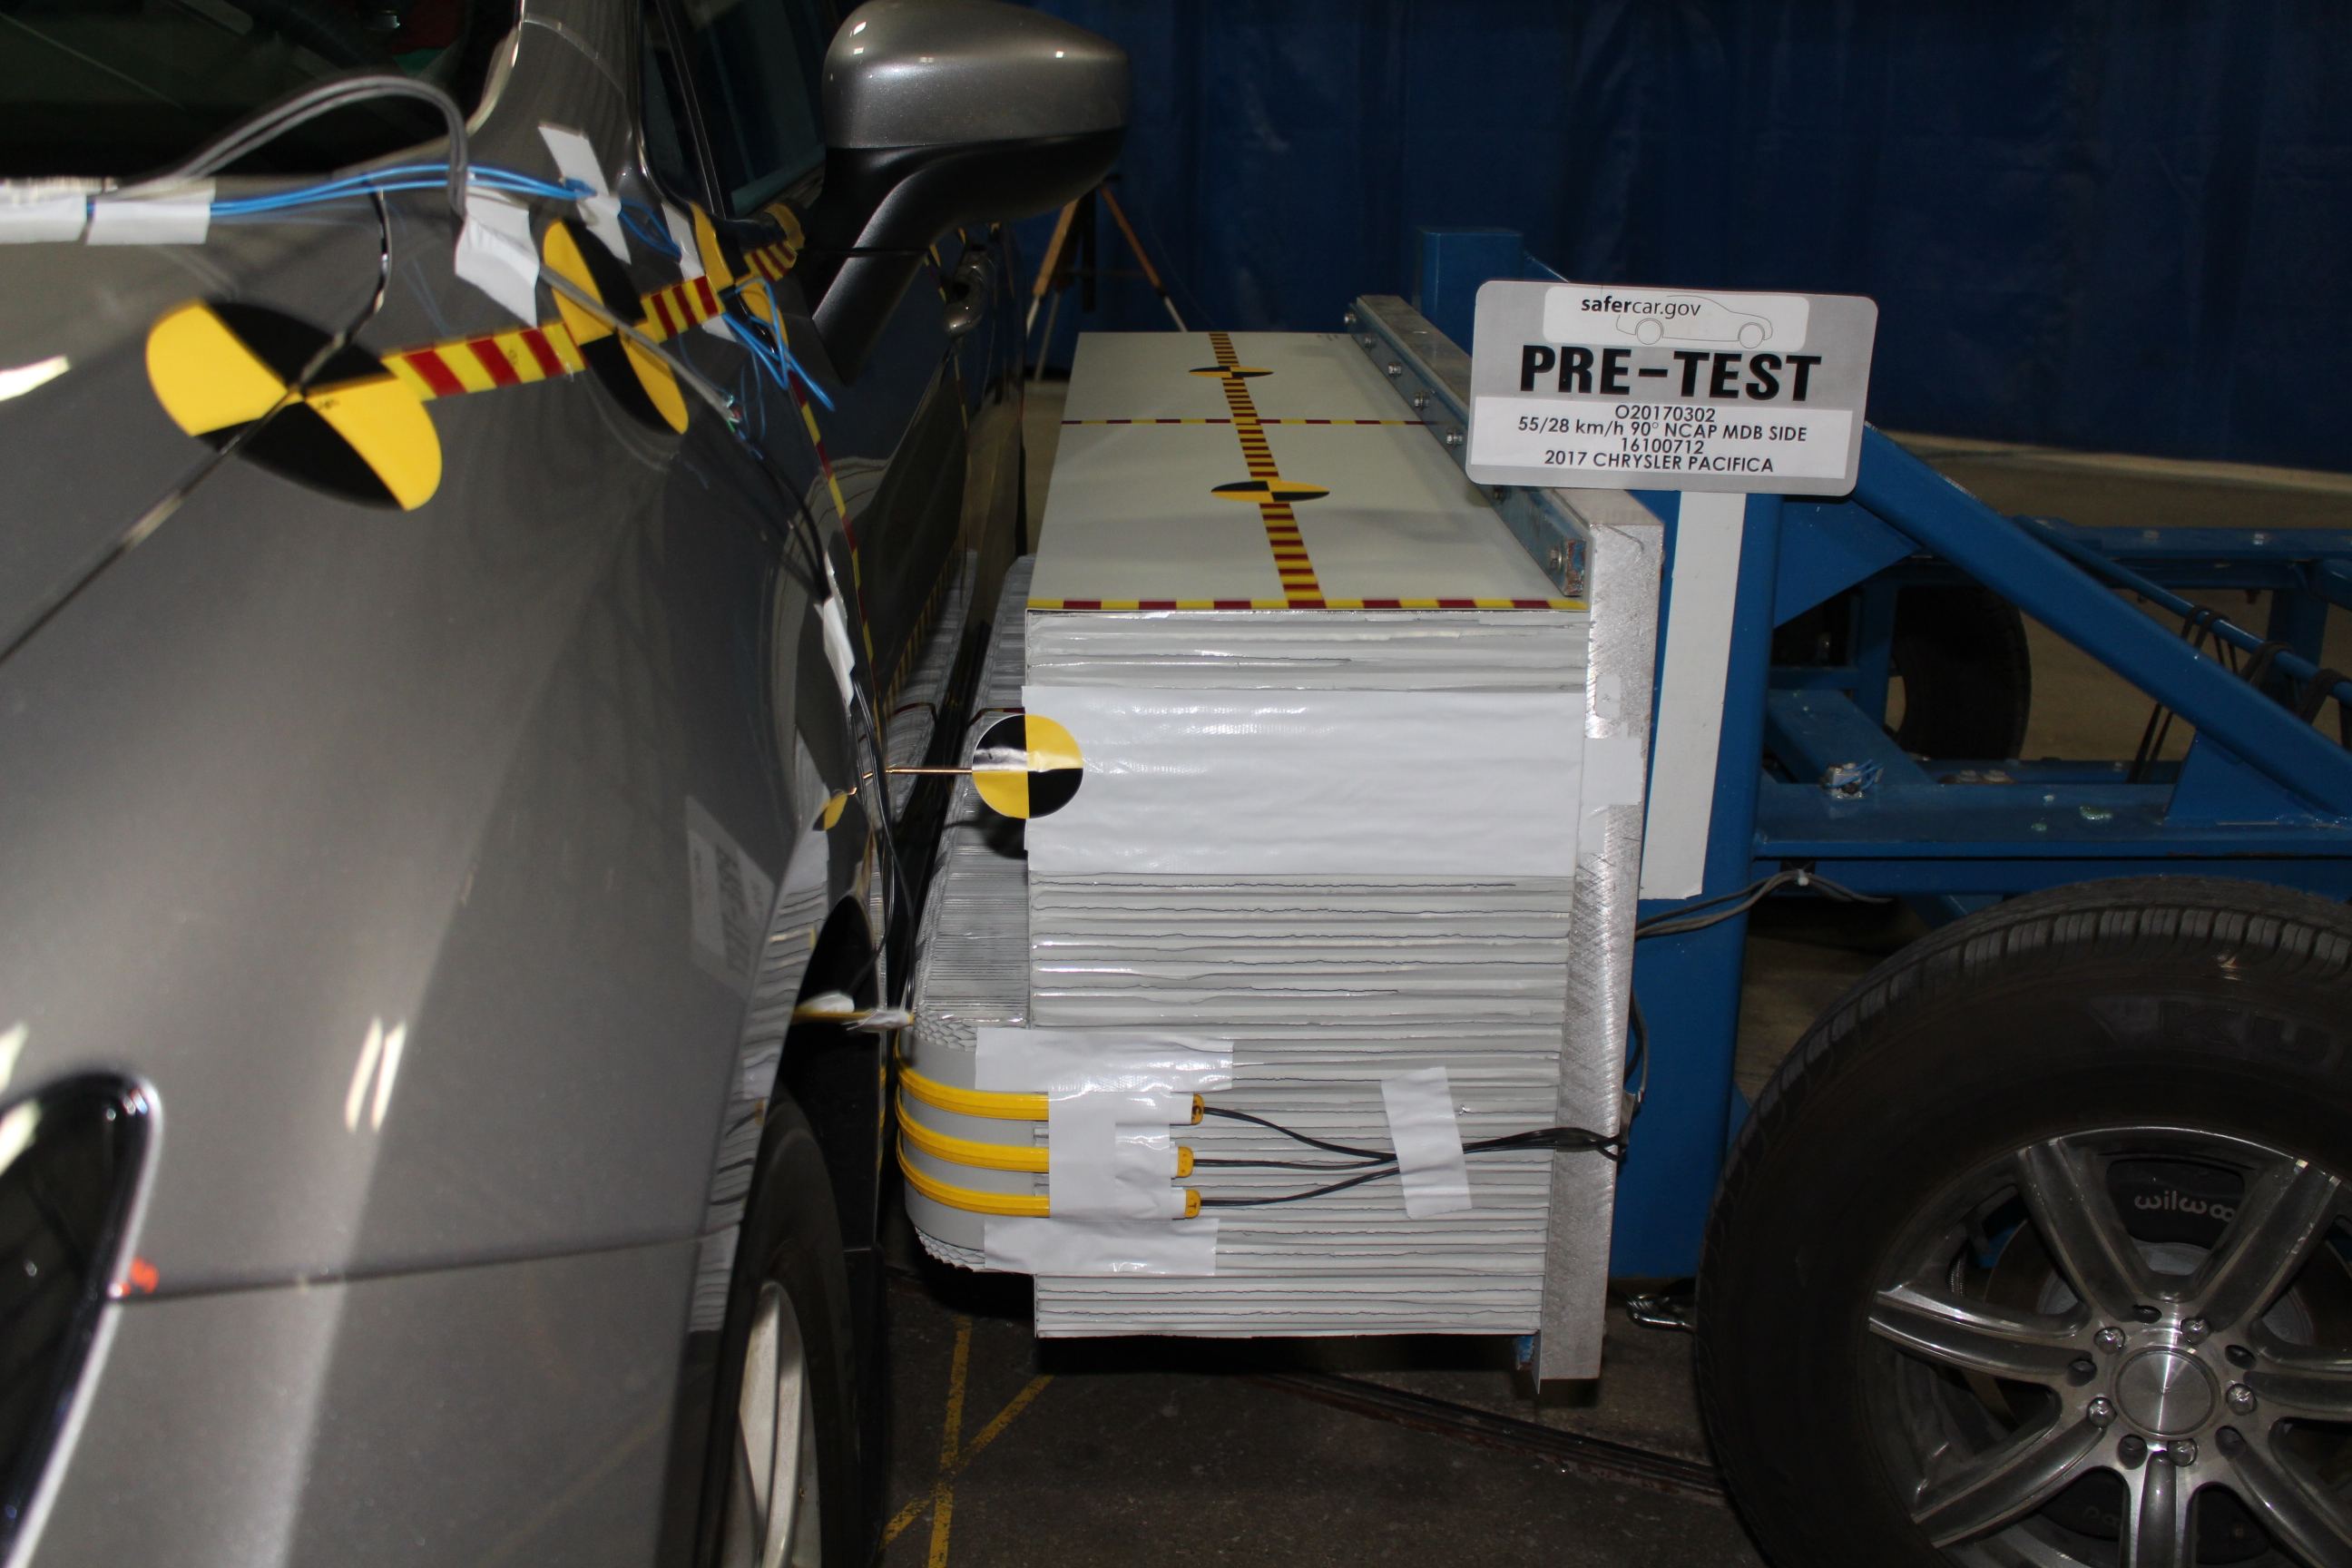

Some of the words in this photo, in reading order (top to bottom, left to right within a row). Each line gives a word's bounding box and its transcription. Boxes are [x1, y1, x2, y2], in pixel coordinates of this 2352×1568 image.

[1582, 296, 1700, 318] safercar.gov
[1520, 345, 1821, 401] PRE-TEST
[1615, 405, 1716, 422] O20170302
[1518, 416, 1570, 434] 55/28
[1575, 419, 1623, 437] km/h
[1631, 421, 1659, 436] 90°
[1664, 423, 1717, 438] NCAP
[1722, 425, 1763, 440] MDB
[1769, 426, 1808, 441] SIDE
[1622, 437, 1704, 454] 16100712
[1544, 450, 1587, 466] 2017
[1592, 452, 1681, 469] CHRYSLER
[1688, 456, 1773, 472] PACIFICA
[2159, 1002, 2352, 1063] KU
[2134, 1190, 2236, 1222] wilwoo
